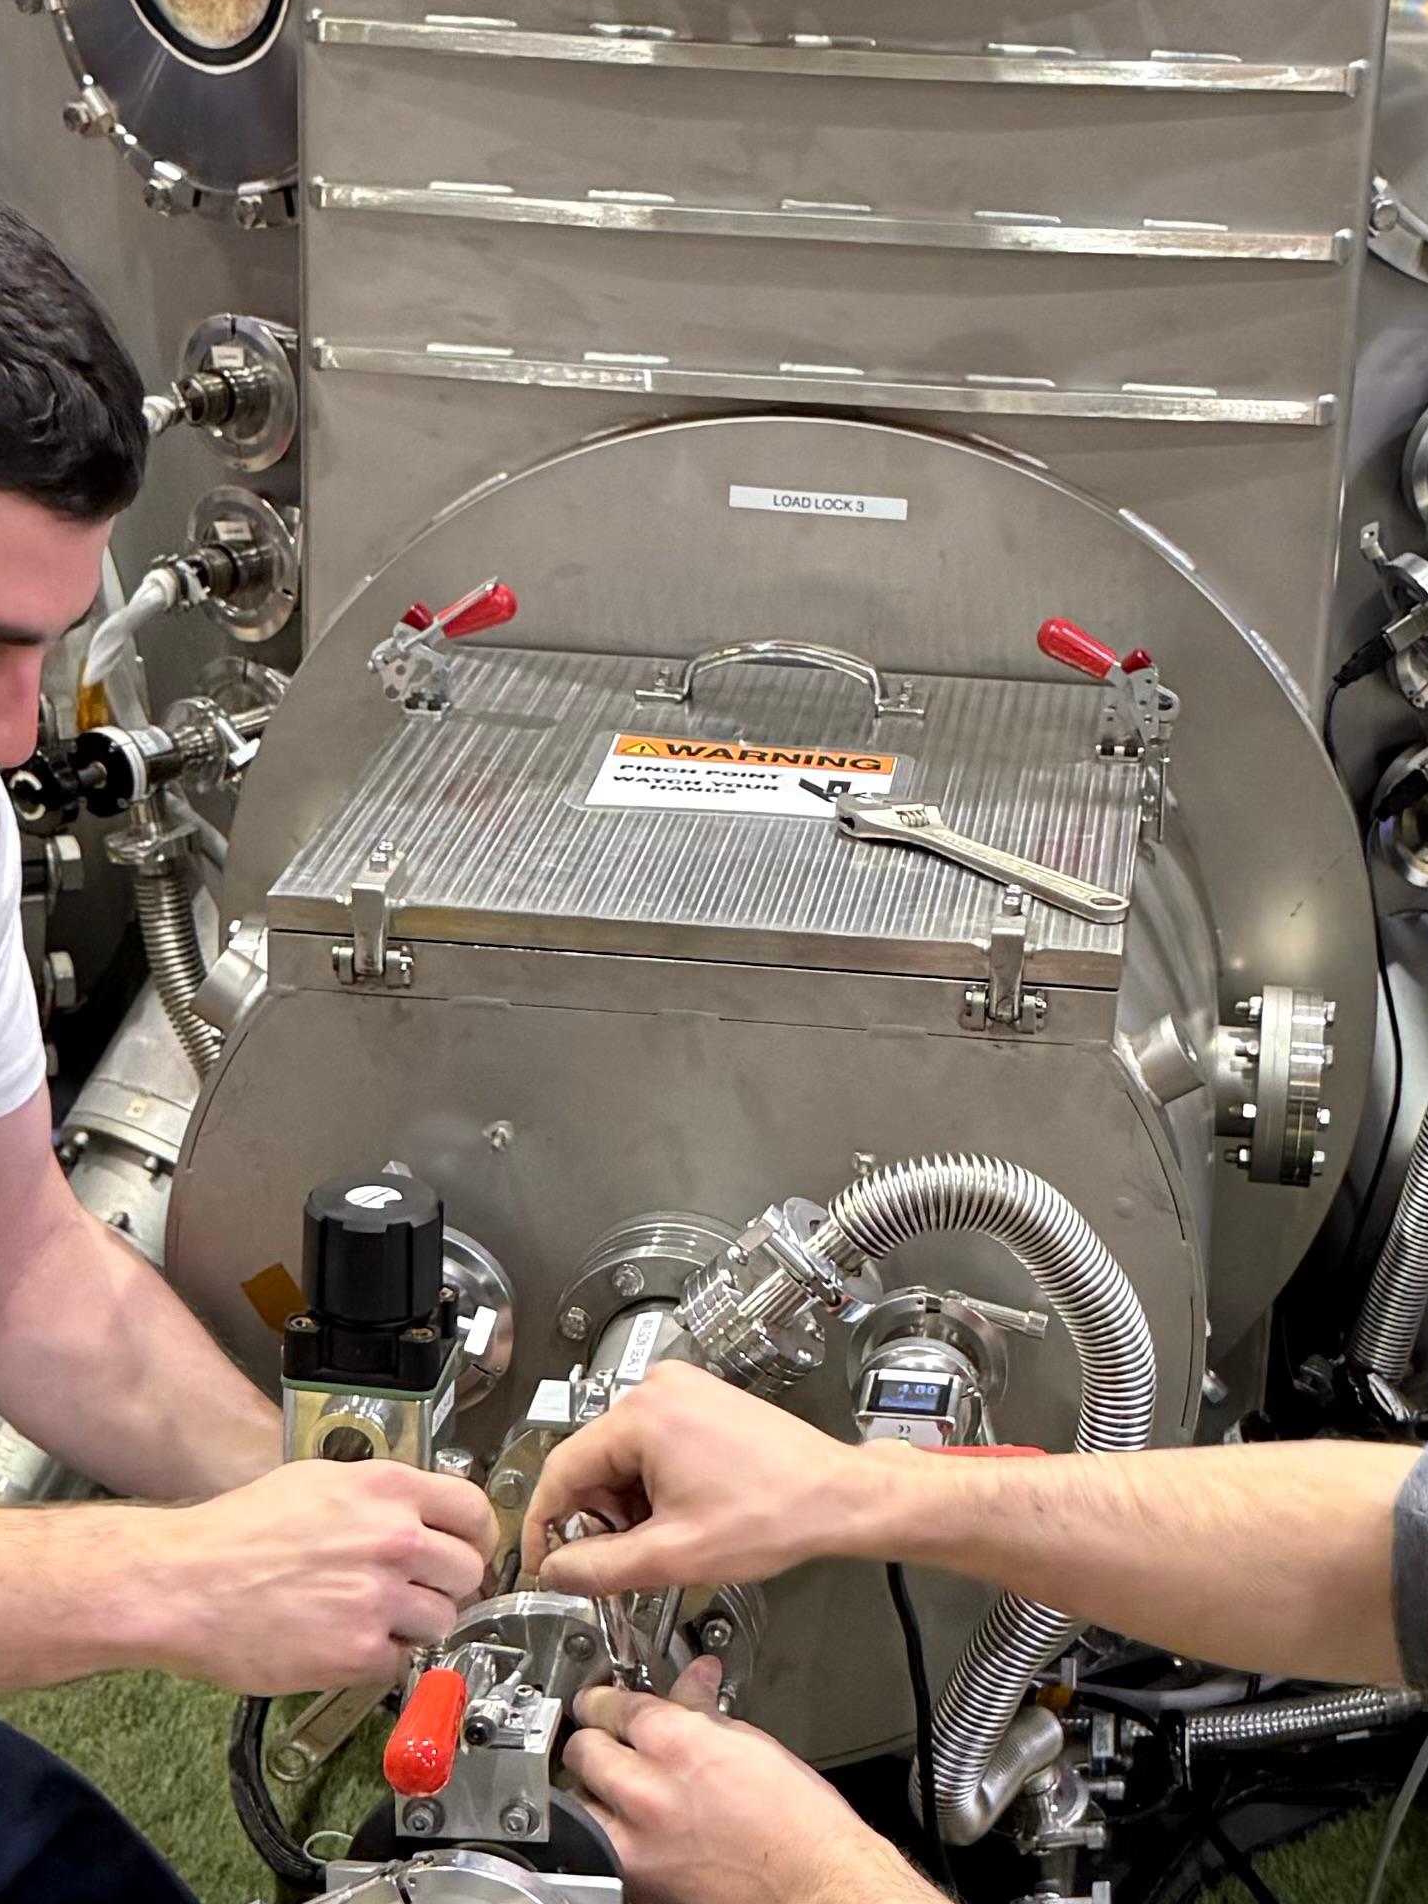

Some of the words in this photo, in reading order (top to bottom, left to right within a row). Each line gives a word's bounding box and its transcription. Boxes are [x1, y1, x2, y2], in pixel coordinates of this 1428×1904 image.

[772, 494, 812, 509] LOAD
[814, 496, 854, 512] LOCK
[855, 500, 865, 513] 3
[665, 742, 882, 771] WARNING
[619, 763, 698, 775] PINCH
[705, 769, 786, 780] POINT
[612, 775, 702, 786] WATCH
[709, 780, 780, 791] YOUR
[649, 784, 737, 795] HANDS
